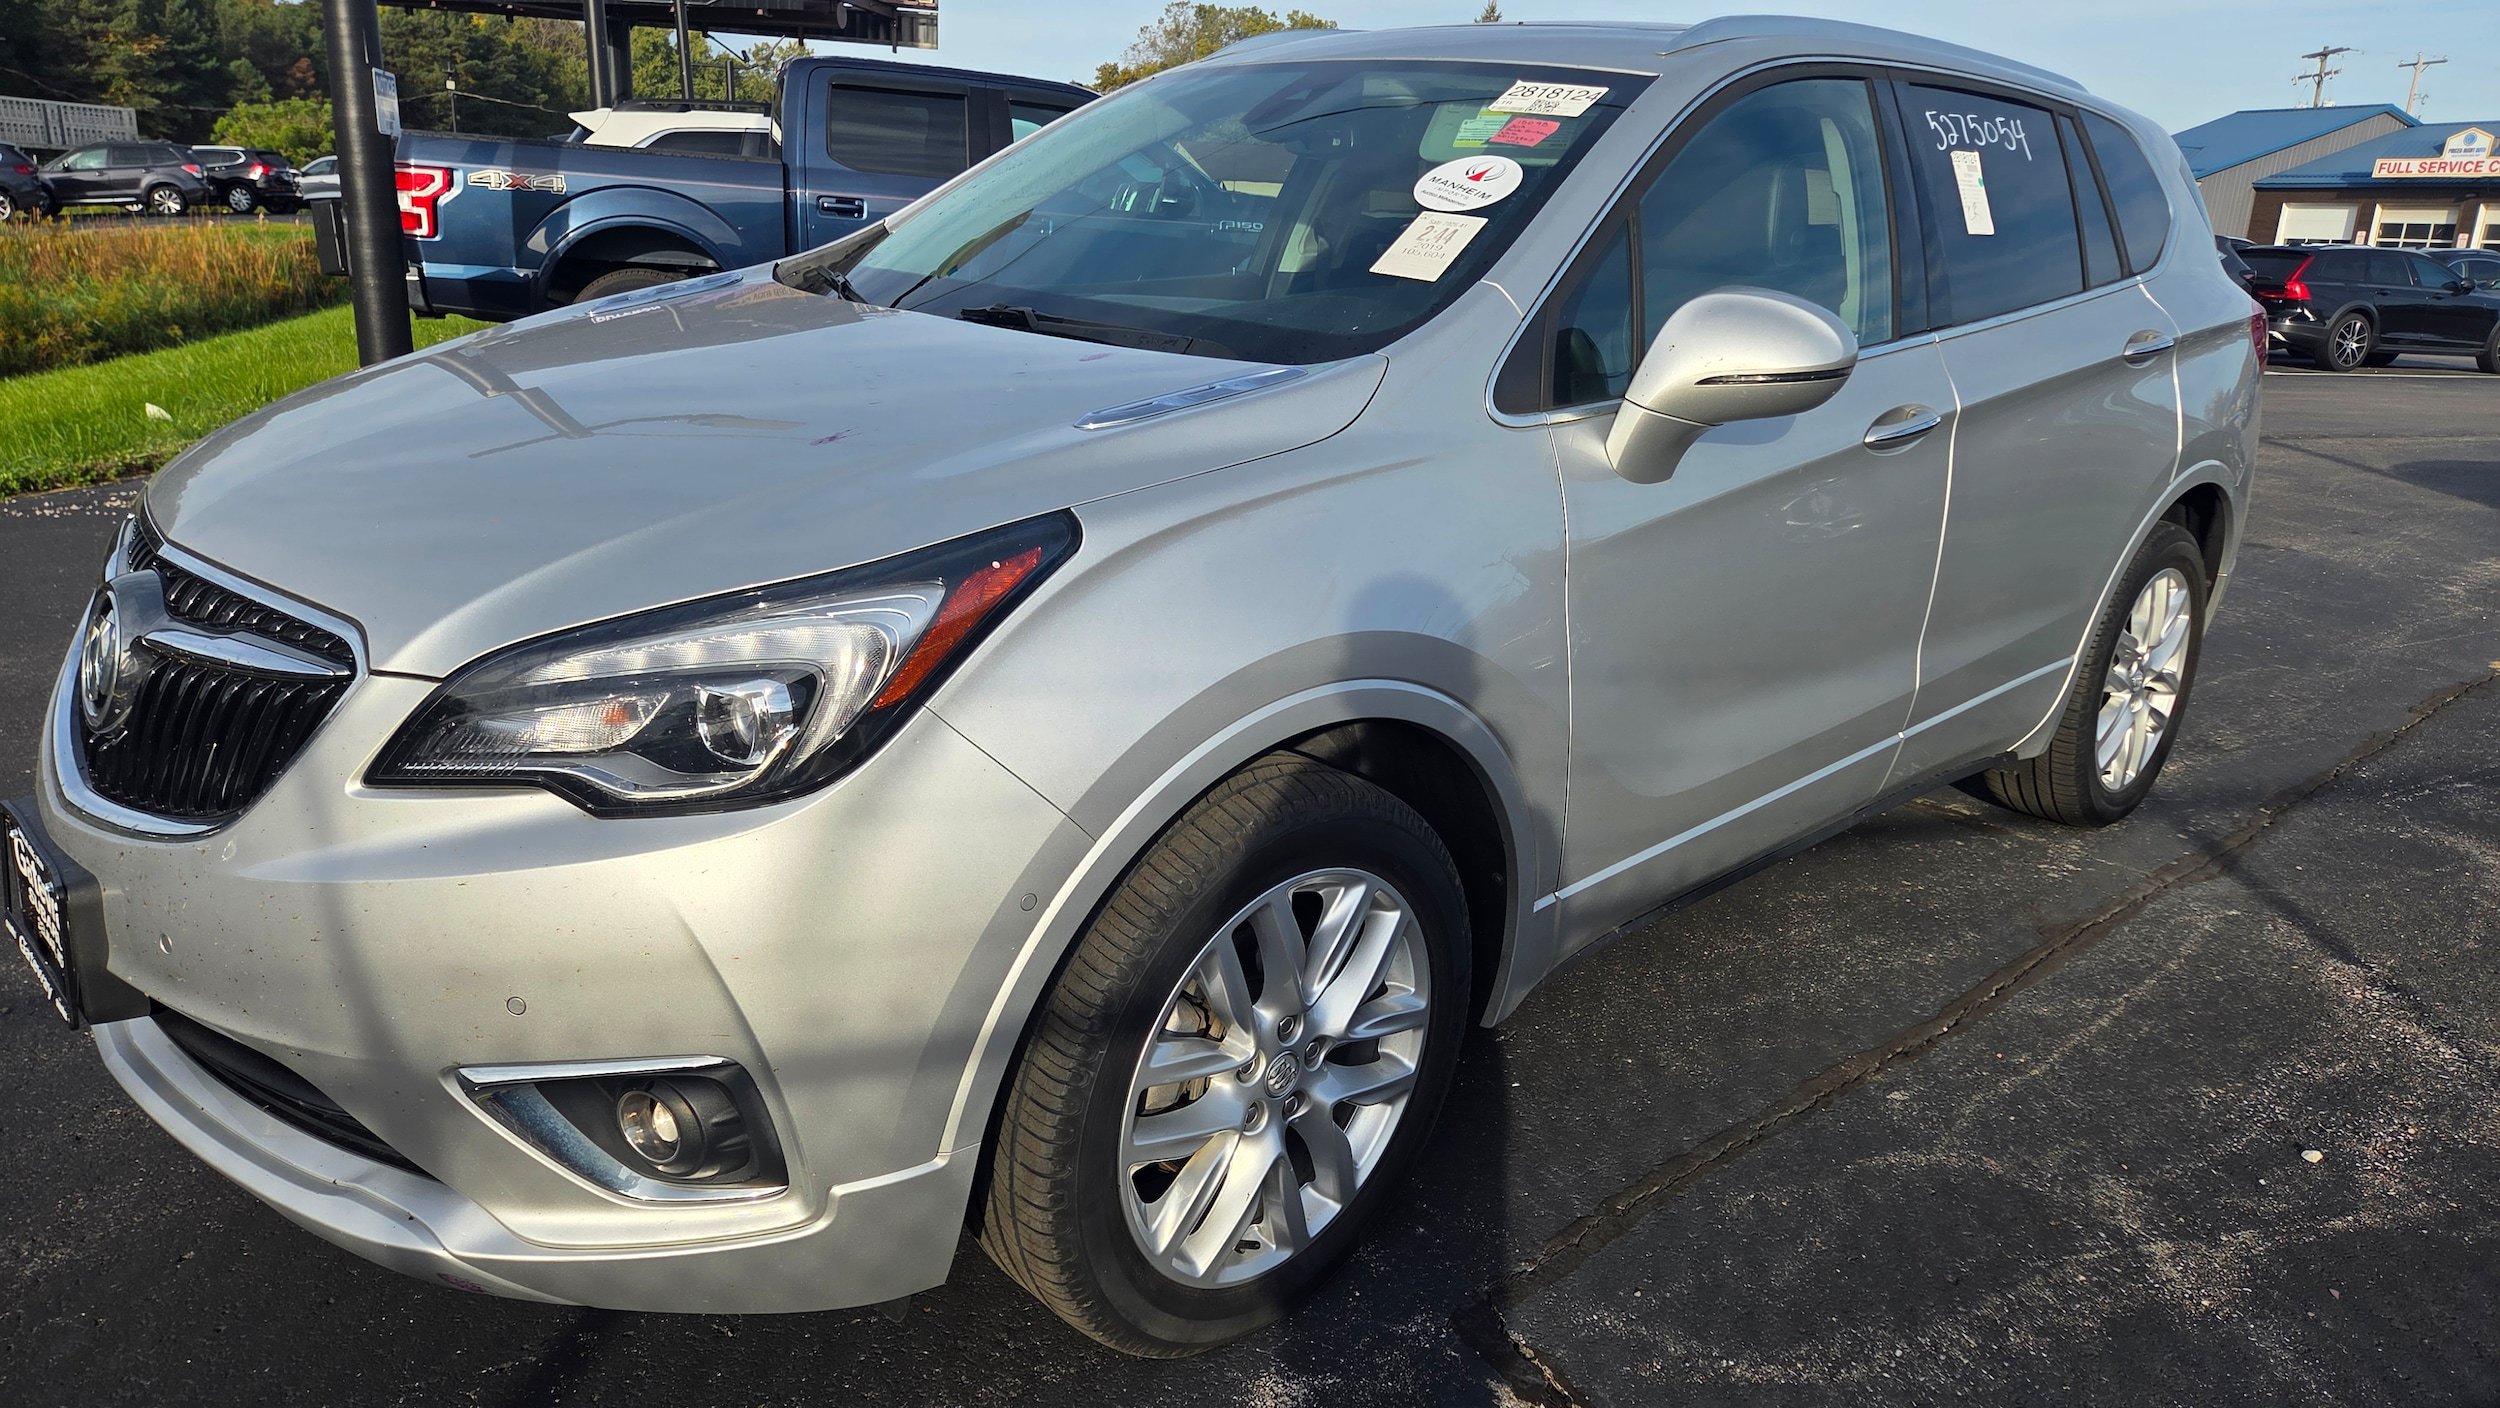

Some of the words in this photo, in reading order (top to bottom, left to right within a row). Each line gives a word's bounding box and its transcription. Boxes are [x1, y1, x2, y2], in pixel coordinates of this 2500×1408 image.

[1508, 85, 1601, 102] 2818124
[1925, 111, 2032, 161] 5275054
[2378, 162, 2413, 174] FULL
[2417, 160, 2485, 174] SERVICE
[1428, 176, 1492, 200] MANHEIM
